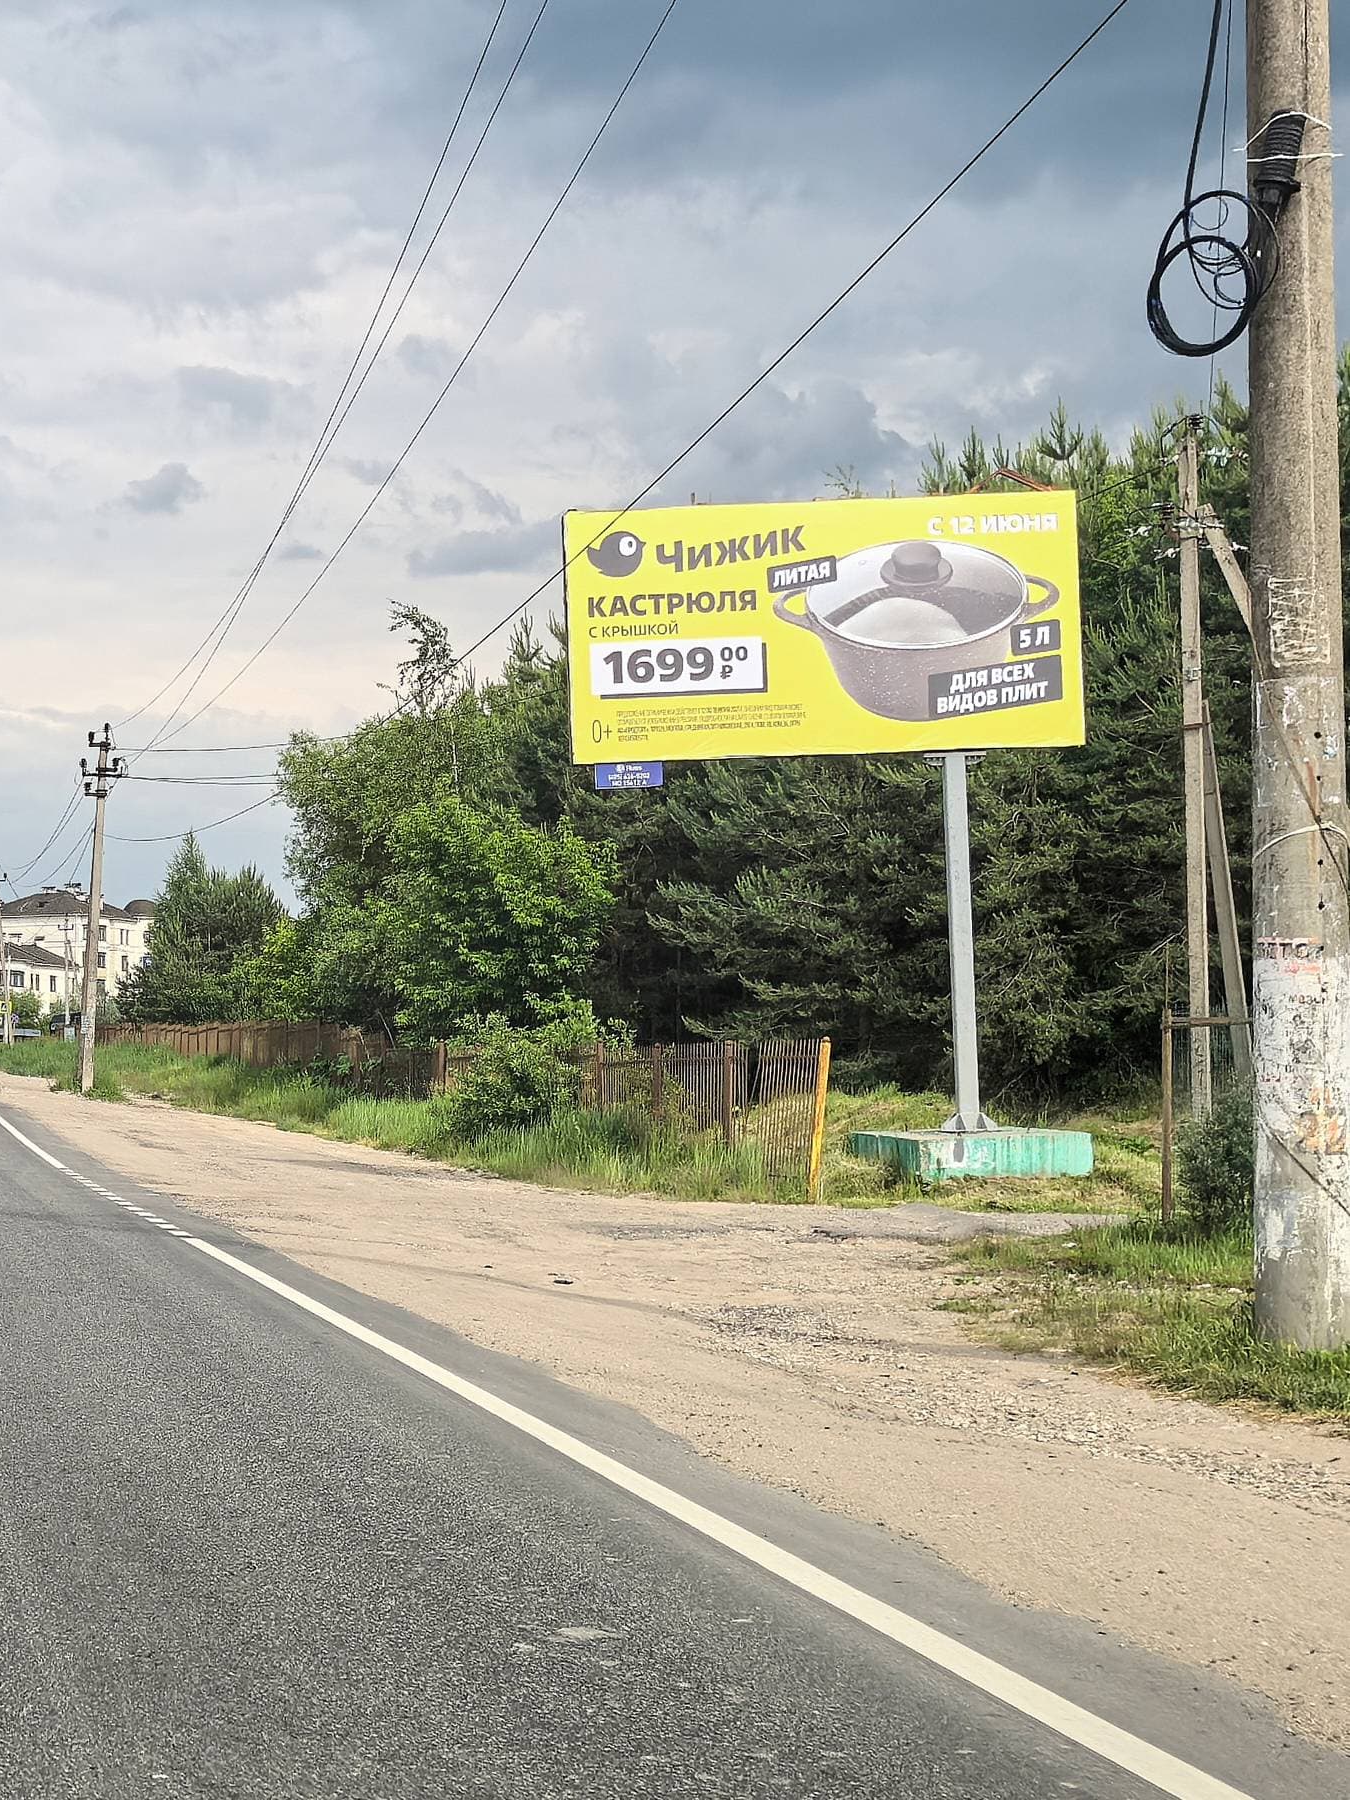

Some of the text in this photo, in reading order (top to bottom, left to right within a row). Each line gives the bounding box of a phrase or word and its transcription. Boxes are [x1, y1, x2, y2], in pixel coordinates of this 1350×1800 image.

[927, 513, 1059, 535] С 12 ИЮНЯ
[773, 560, 831, 588] ЛИТАЯ
[587, 589, 757, 618] КАСТРЮЛЯ
[588, 620, 679, 639] С КРЫШКОЙ
[1019, 625, 1050, 649] 5 Л
[603, 647, 714, 684] 1699
[949, 662, 1035, 693] ДЛЯ ВСЕХ
[937, 681, 1048, 714] ВИДОВ ПЛИТ
[592, 719, 613, 743] 0+
